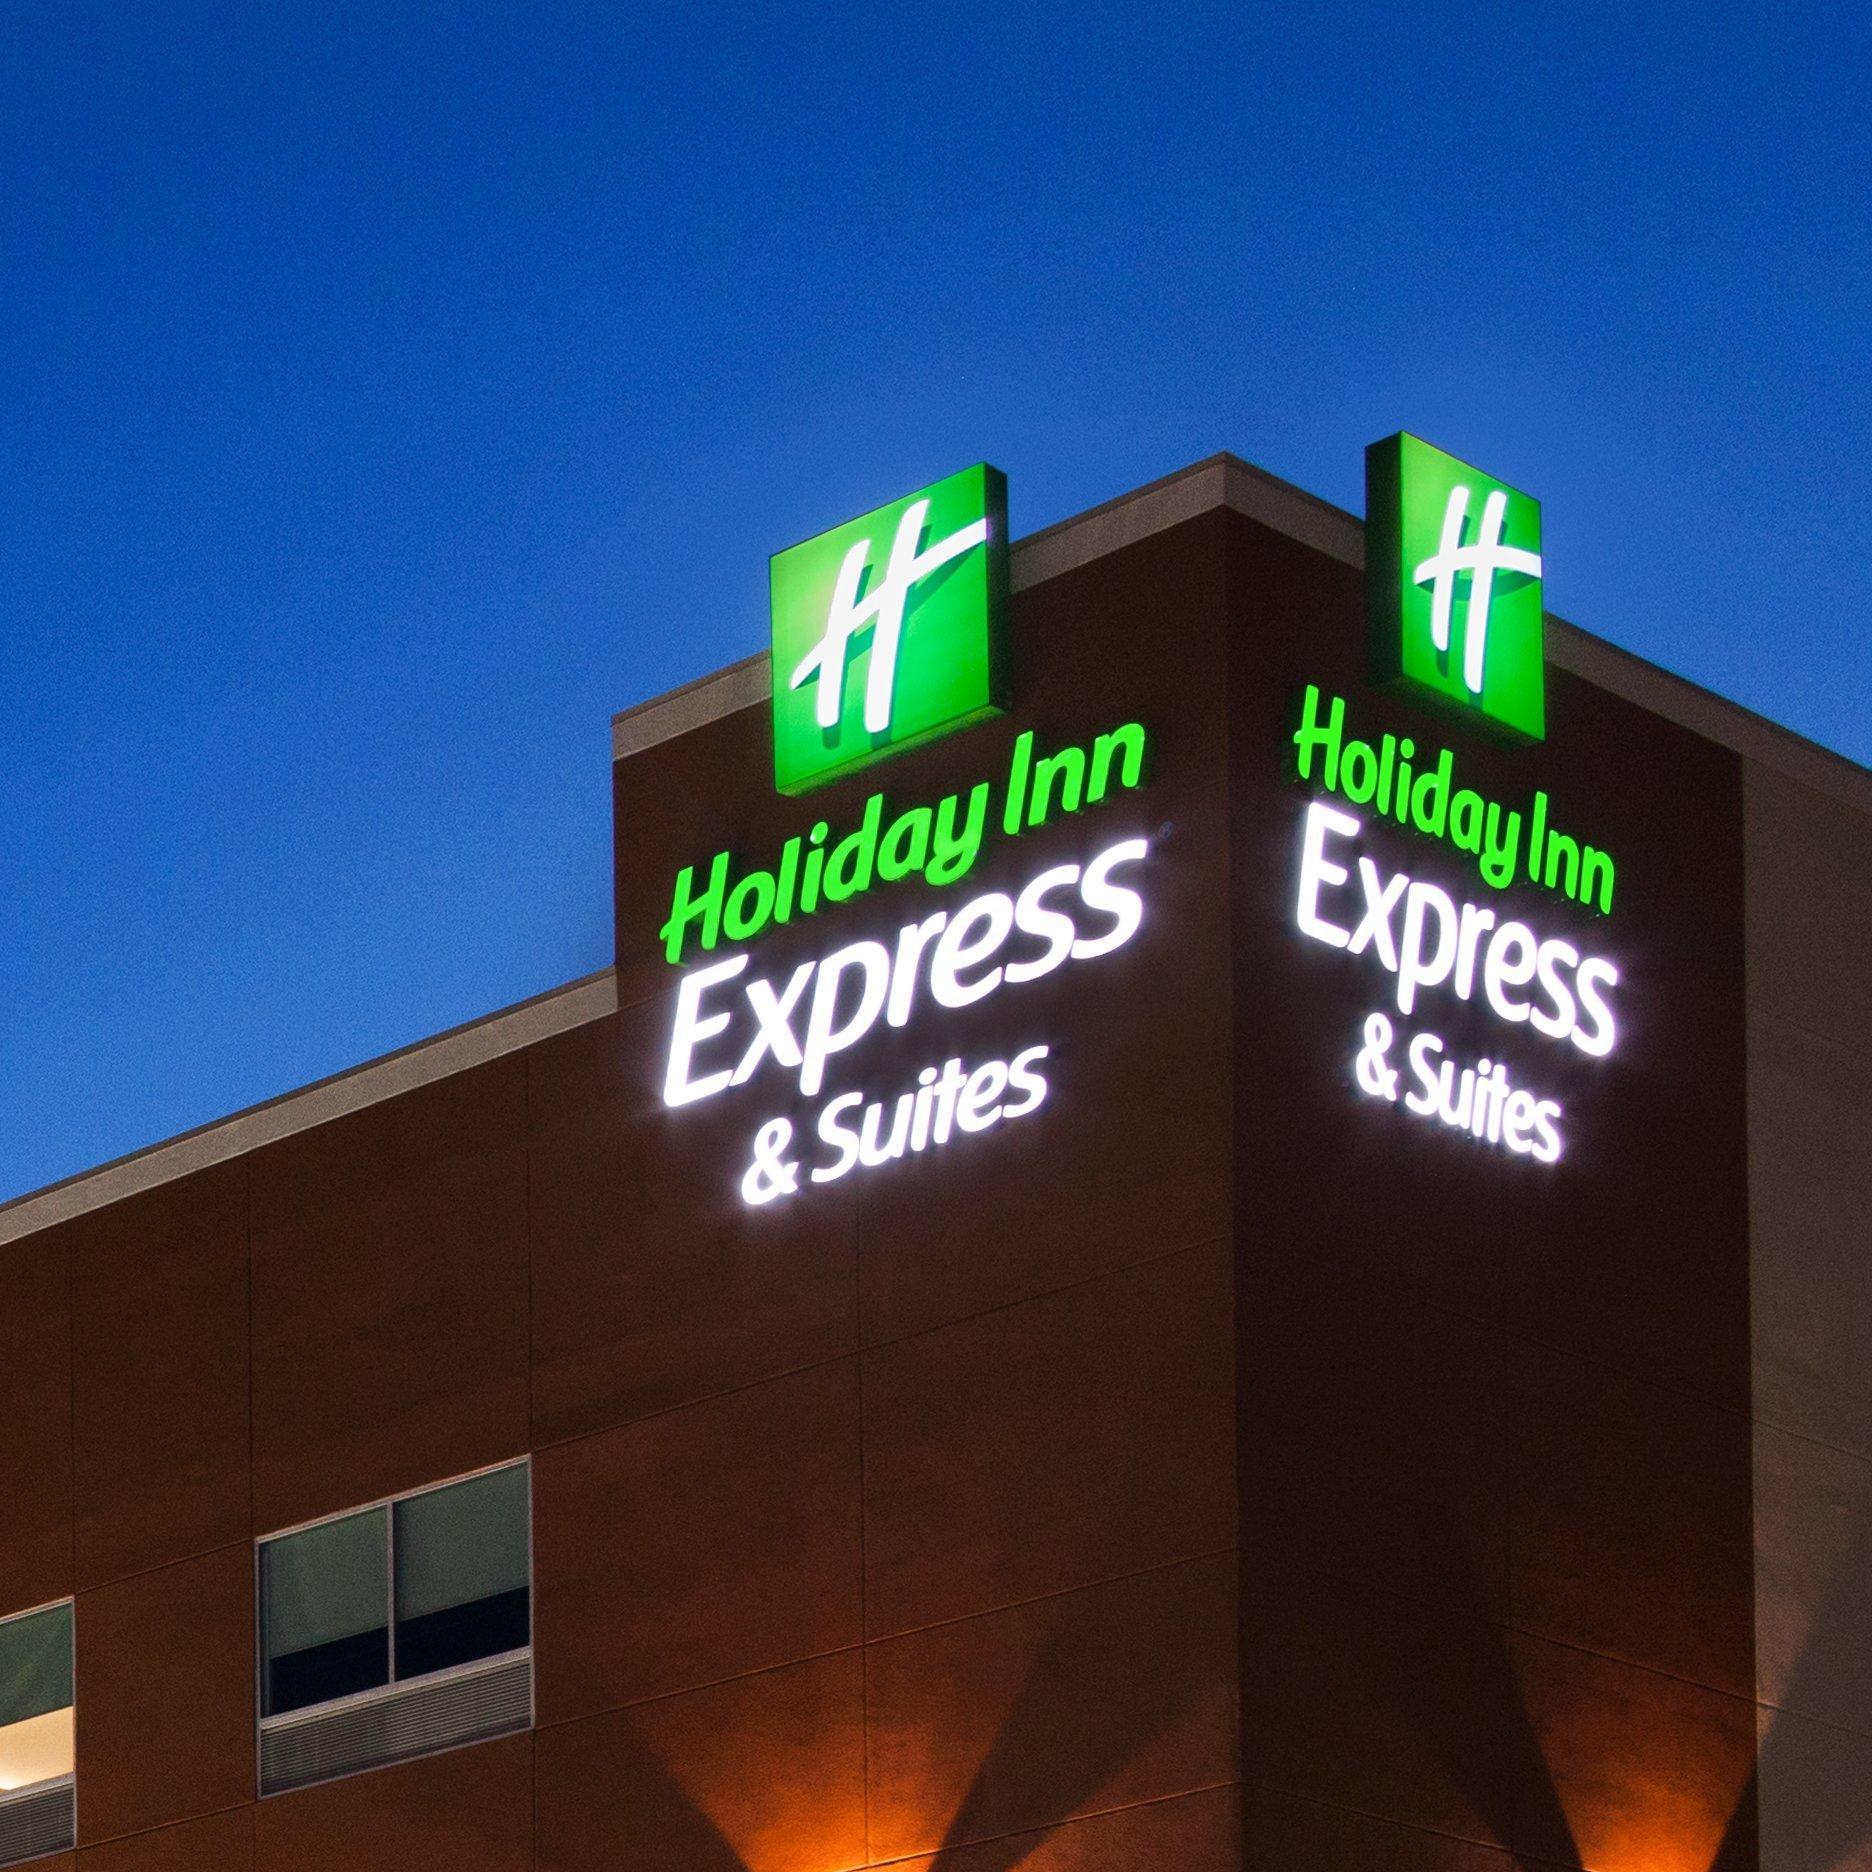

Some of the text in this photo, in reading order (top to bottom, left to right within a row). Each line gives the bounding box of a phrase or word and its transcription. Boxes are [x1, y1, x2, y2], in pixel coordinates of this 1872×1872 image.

[659, 722, 1146, 965] Holiday Inn
[1293, 684, 1615, 915] Holiday Inn
[663, 839, 1149, 1108] Express
[1296, 802, 1619, 1057] Express
[741, 1044, 1049, 1205] & Suites
[1355, 1012, 1561, 1163] & Suites
